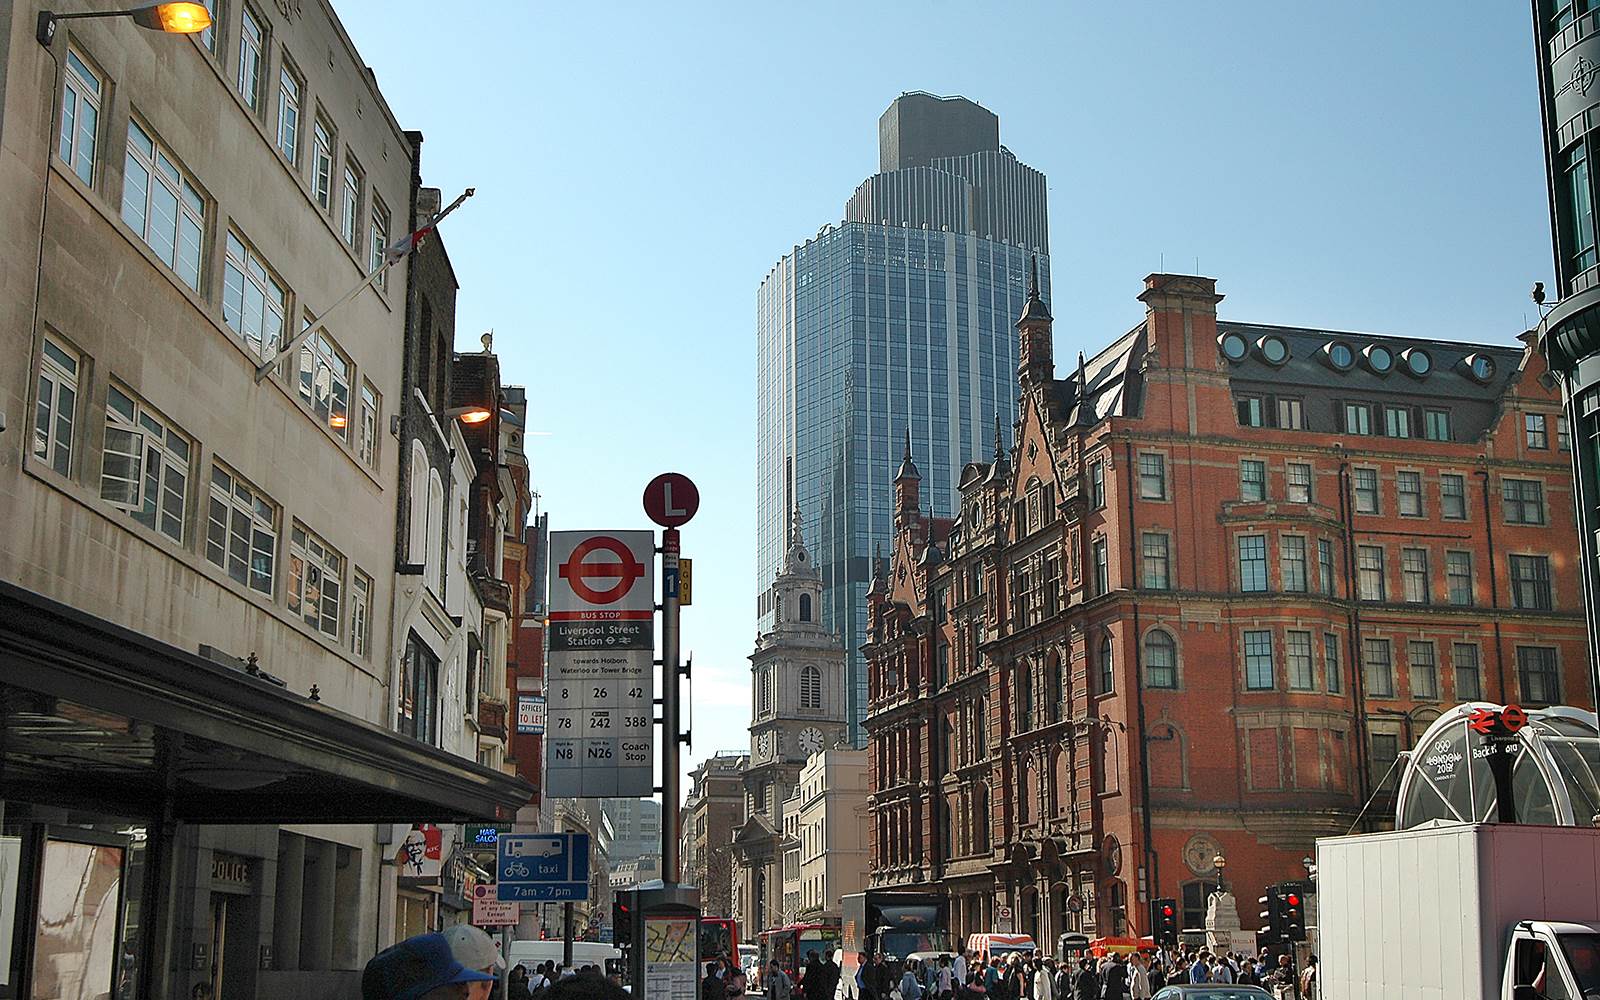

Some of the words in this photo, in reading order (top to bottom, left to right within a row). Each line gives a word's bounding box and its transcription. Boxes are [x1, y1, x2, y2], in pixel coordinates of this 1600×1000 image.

[664, 483, 686, 516] L
[666, 574, 675, 593] 1
[600, 611, 621, 619] STOP
[559, 626, 605, 636] Liverpool
[609, 625, 640, 634] Street
[568, 636, 603, 646] Station
[622, 667, 642, 675] Bridge
[561, 688, 569, 699] 8
[593, 687, 608, 698] 26
[628, 687, 643, 698] 42
[520, 704, 542, 712] OFFICES
[520, 714, 528, 723] TO
[532, 715, 542, 724] LET
[558, 717, 572, 729] 78
[590, 717, 610, 728] 242
[624, 716, 647, 727] 388
[622, 743, 650, 751] Coach
[1472, 745, 1490, 759] Back
[556, 749, 573, 759] N8
[588, 748, 612, 758] N26
[625, 752, 646, 761] Stop
[1426, 752, 1462, 766] LONDON
[211, 861, 248, 882] POLICE
[539, 864, 559, 873] taxi
[513, 886, 537, 897] 7am
[547, 886, 571, 897] 7pm
